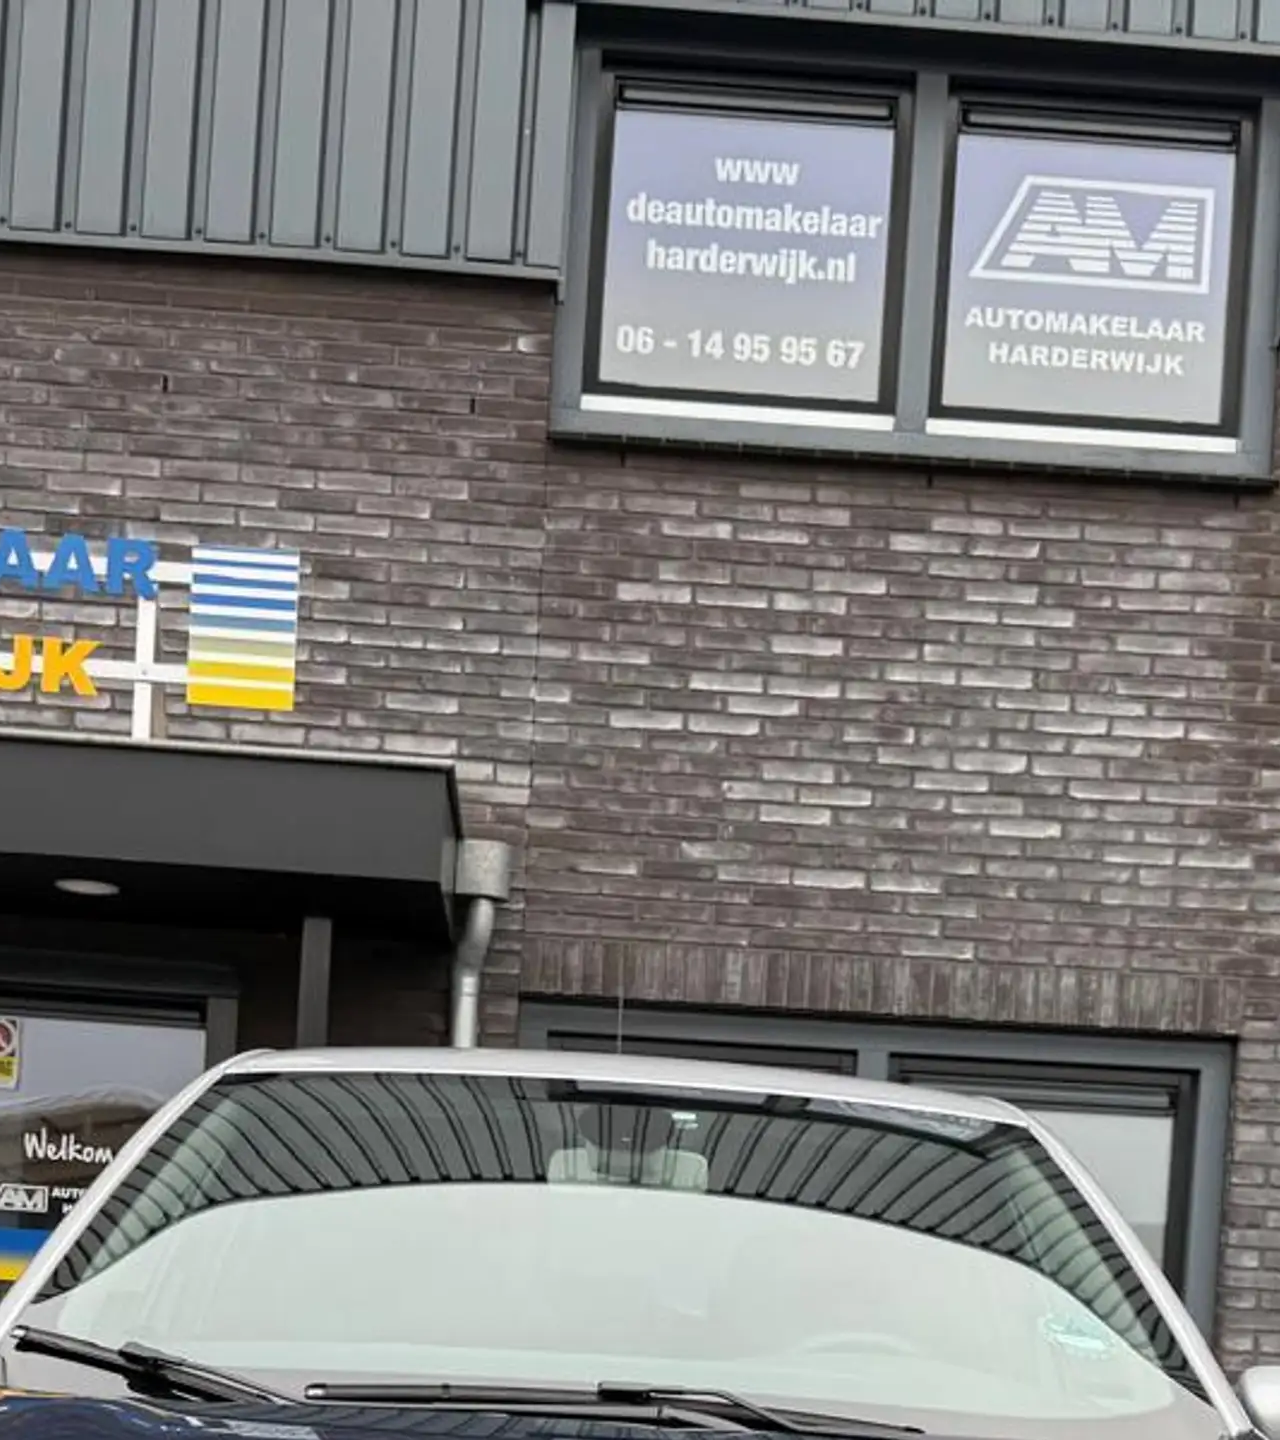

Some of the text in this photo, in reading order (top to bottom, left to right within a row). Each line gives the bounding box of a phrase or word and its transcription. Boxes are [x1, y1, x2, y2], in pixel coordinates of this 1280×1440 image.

[715, 155, 800, 185] www
[626, 192, 883, 240] deautomakelaar
[646, 240, 857, 283] harderwijk.nl
[965, 306, 1206, 343] AUTOMAKELAAR
[616, 324, 655, 355] 06
[687, 329, 725, 360] 14
[733, 333, 771, 364] 95
[780, 336, 818, 367] 95
[826, 339, 866, 370] 67
[988, 342, 1184, 376] HARDERWIJK
[23, 1126, 114, 1164] Welkom
